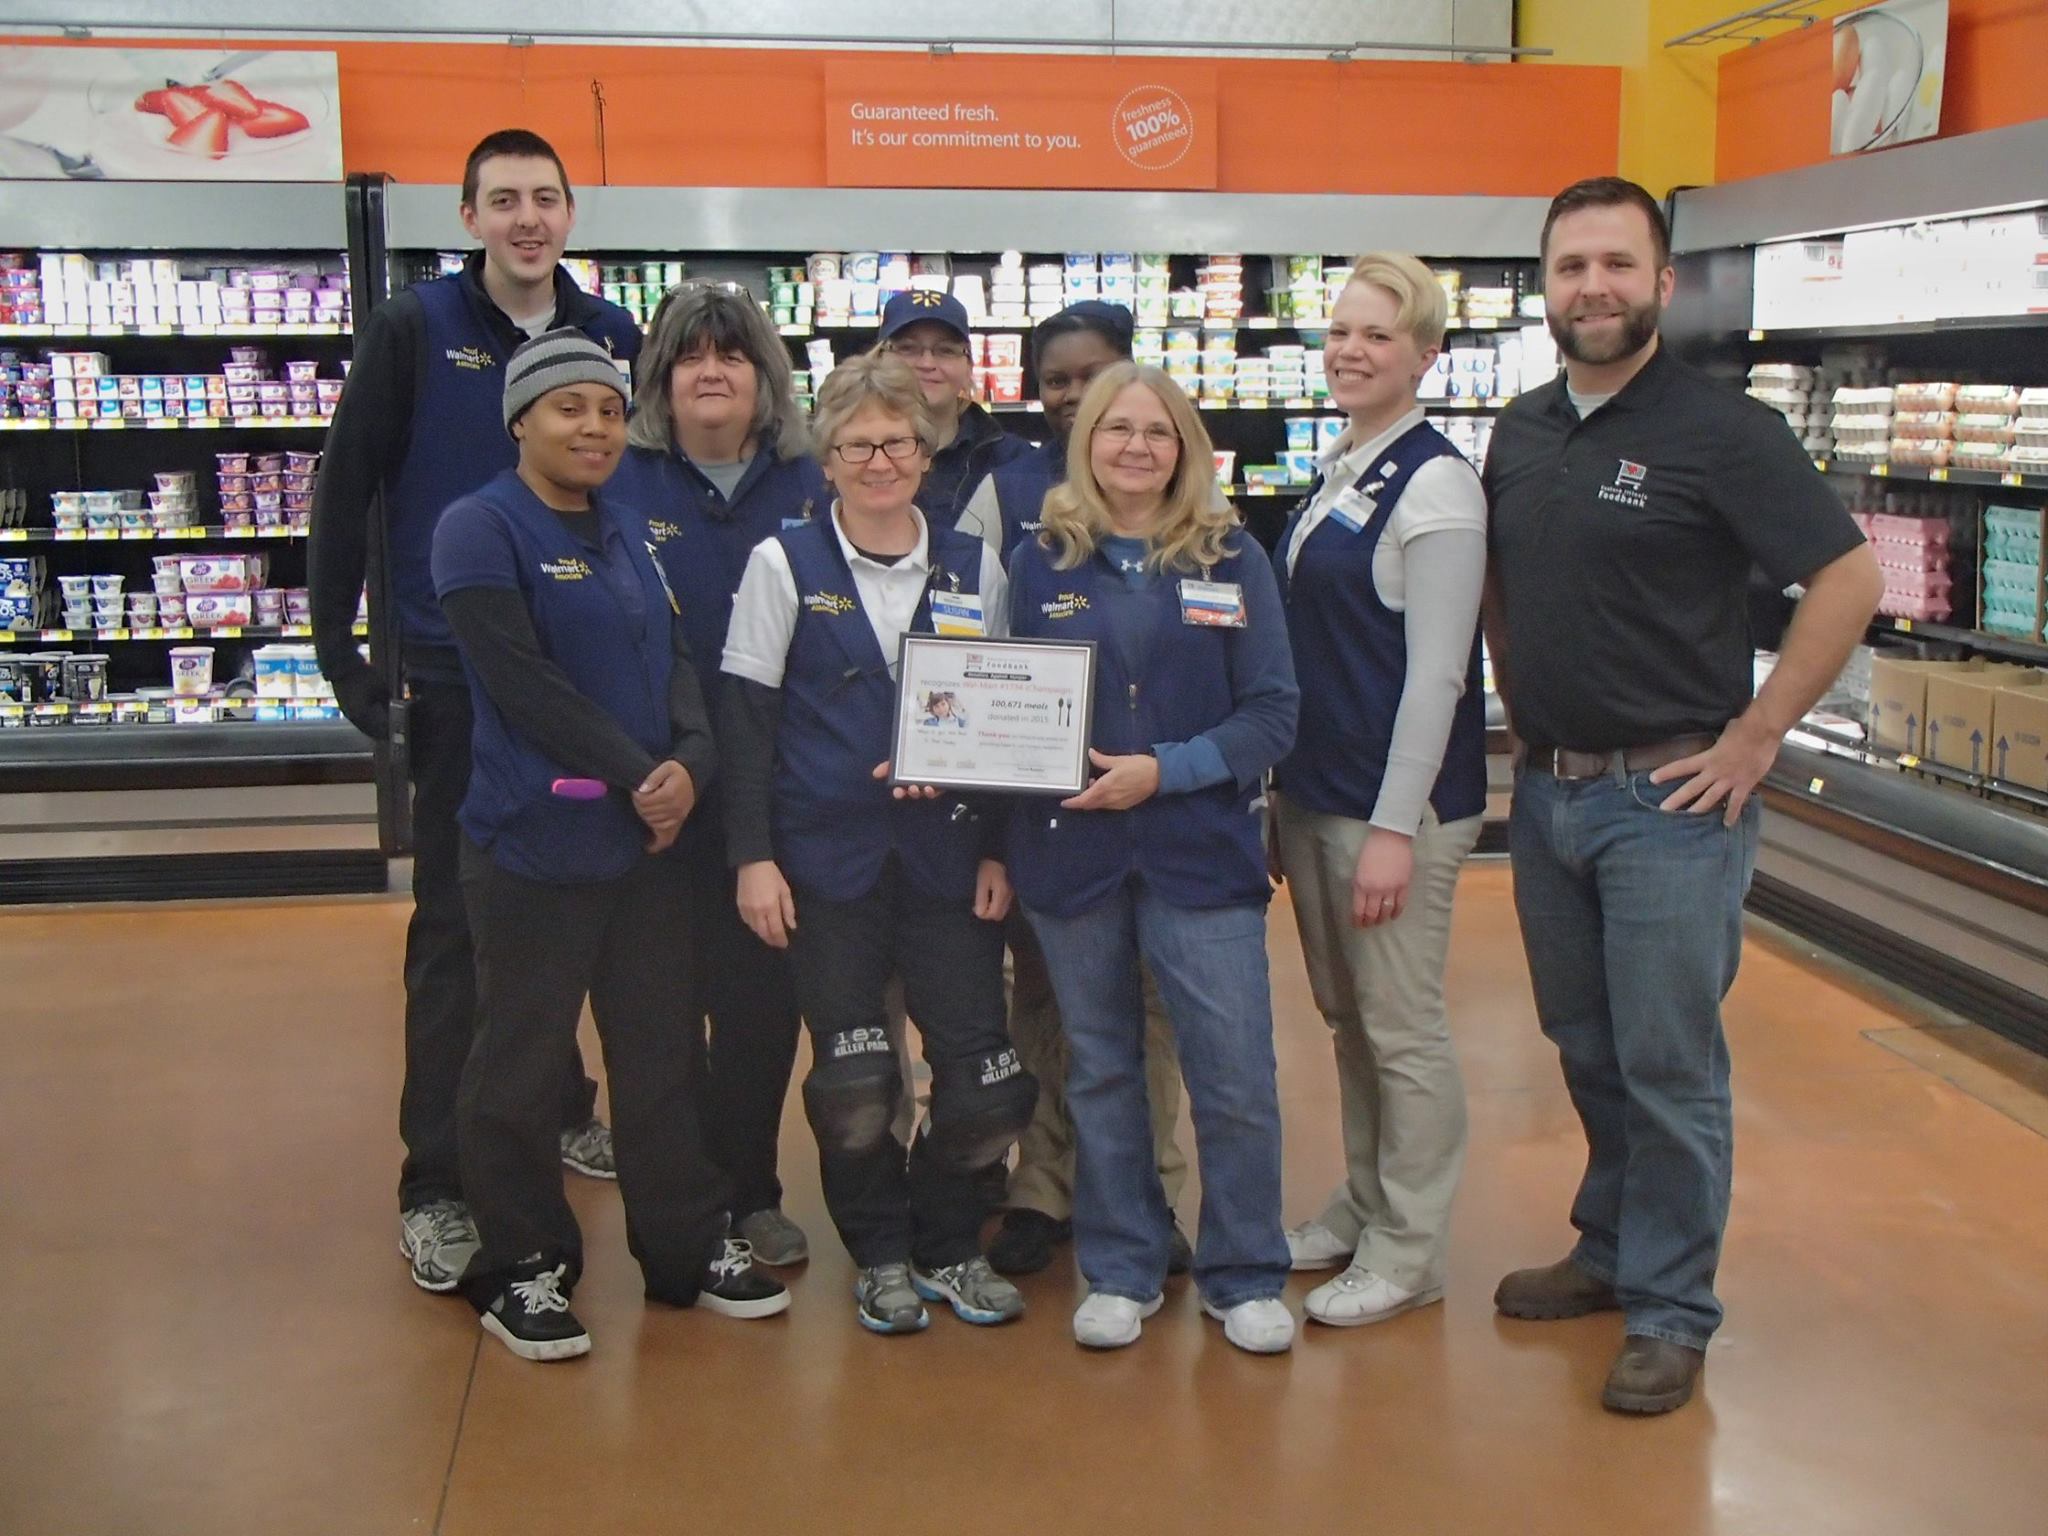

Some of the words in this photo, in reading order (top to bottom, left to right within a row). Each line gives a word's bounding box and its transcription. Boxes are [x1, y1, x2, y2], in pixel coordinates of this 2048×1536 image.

[850, 102, 949, 121] Guaranteed
[955, 103, 999, 121] fresh.
[1121, 96, 1173, 123] freshness
[1125, 109, 1181, 142] 100%
[851, 128, 875, 146] It's
[879, 132, 908, 146] our
[912, 131, 1020, 148] commitment
[1025, 134, 1042, 149] to
[1046, 134, 1081, 152] you.
[1128, 123, 1189, 158] guaranteed
[446, 349, 480, 364] Walmart
[1598, 490, 1645, 508] foodbank
[540, 562, 580, 574] Walmart
[804, 594, 839, 610] Walmart
[1041, 600, 1075, 616] Walmart
[1024, 702, 1049, 711] meals
[837, 1028, 885, 1046] 187
[834, 1041, 866, 1057] KILLER
[983, 1048, 1017, 1073] 187
[981, 1066, 1011, 1085] KILLER
